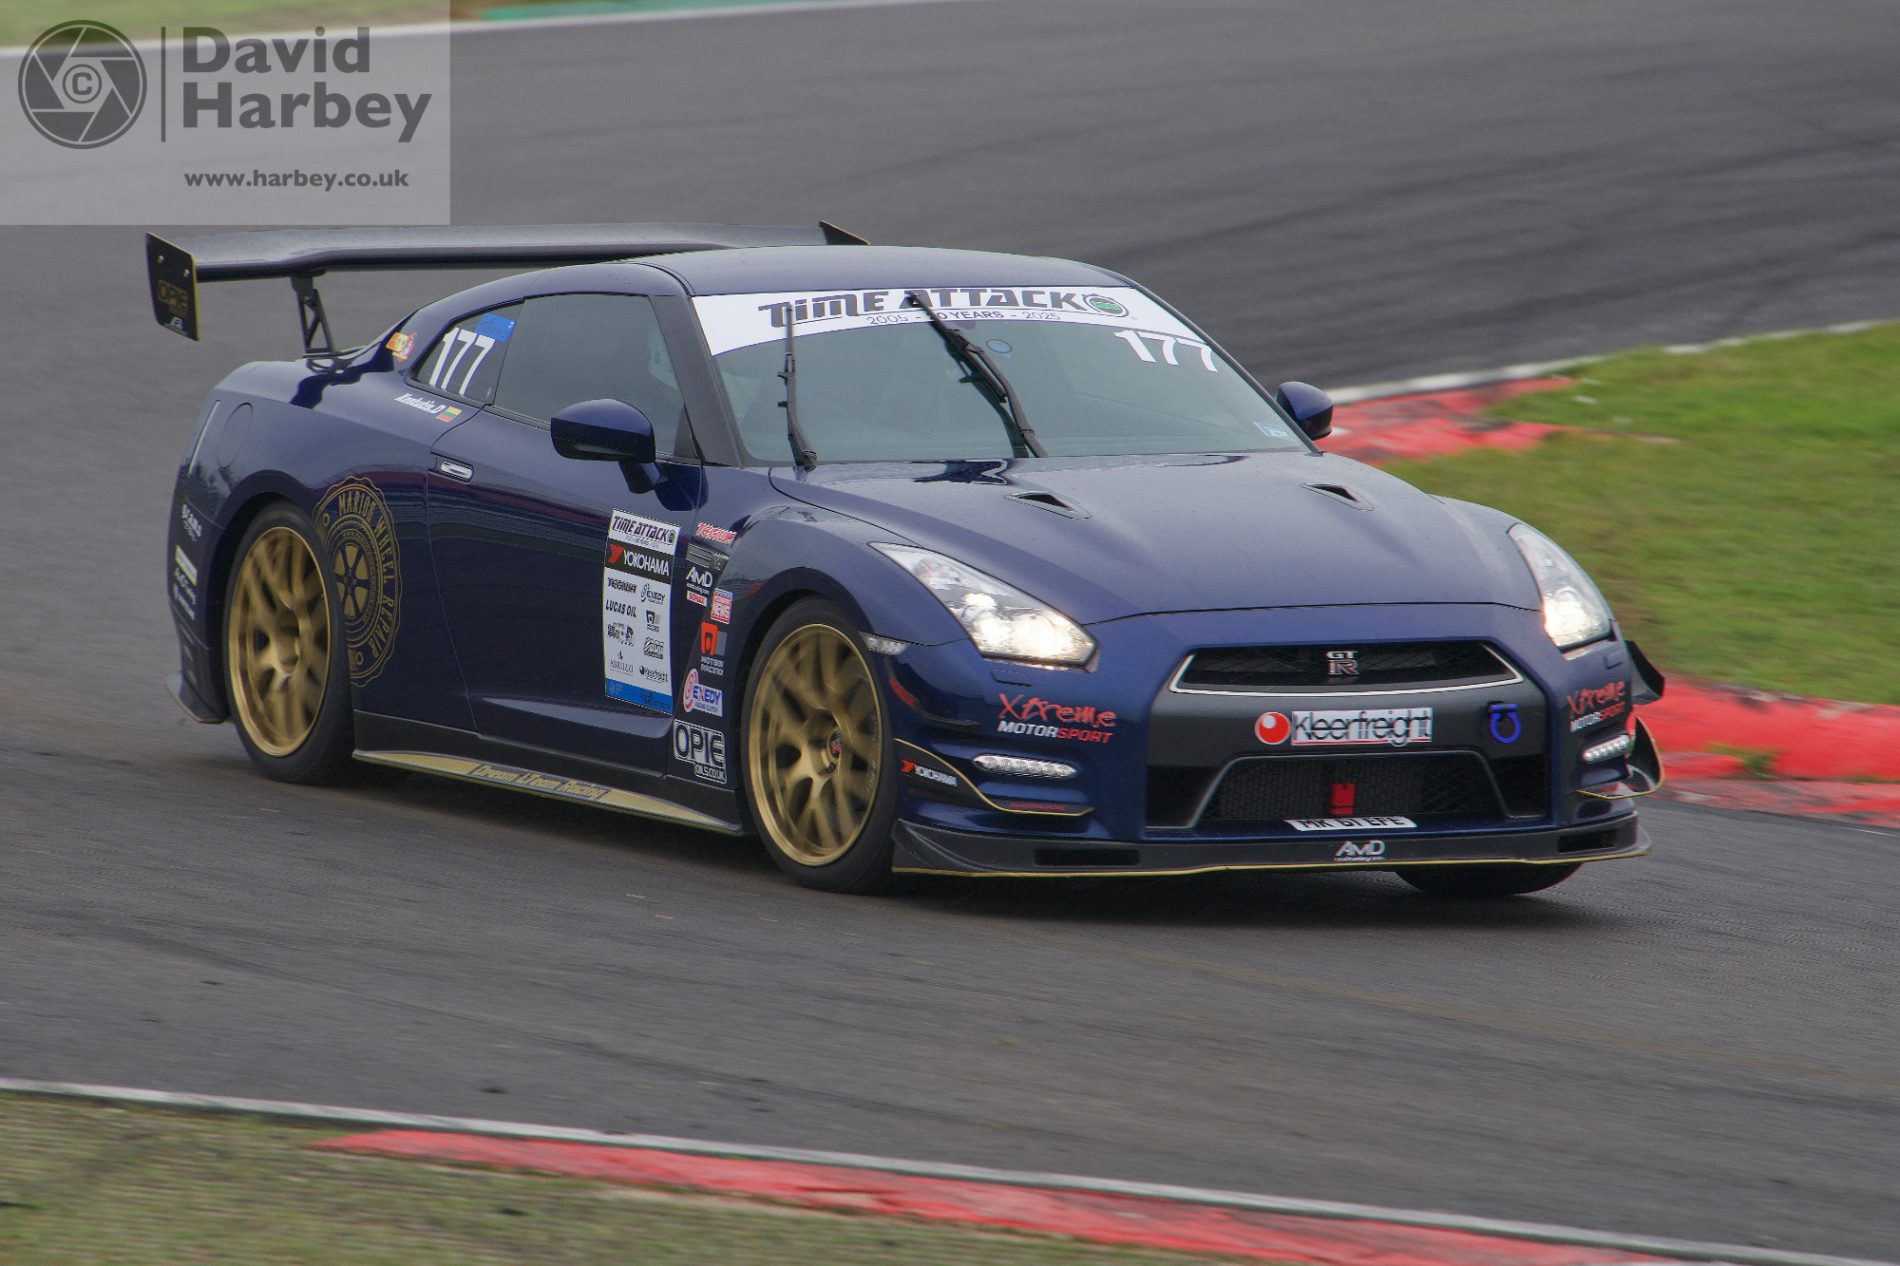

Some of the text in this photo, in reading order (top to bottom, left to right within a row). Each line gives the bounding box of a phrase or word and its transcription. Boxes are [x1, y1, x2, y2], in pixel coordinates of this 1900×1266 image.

[899, 288, 1088, 312] ATTACK
[866, 314, 909, 325] 2005
[950, 310, 1004, 320] YEARS
[1023, 311, 1061, 321] 2025
[428, 327, 496, 396] 177
[1113, 329, 1218, 373] 177
[372, 514, 395, 584] WHEEL
[623, 549, 670, 577] YOKOHAMA
[605, 599, 637, 618] LUCAS OIL
[369, 595, 395, 659] REPAIR
[1326, 650, 1359, 659] GT
[1327, 659, 1360, 675] R
[692, 685, 721, 705] EXEDY
[997, 720, 1114, 744] MOTORSPORT
[557, 780, 609, 800] Racing
